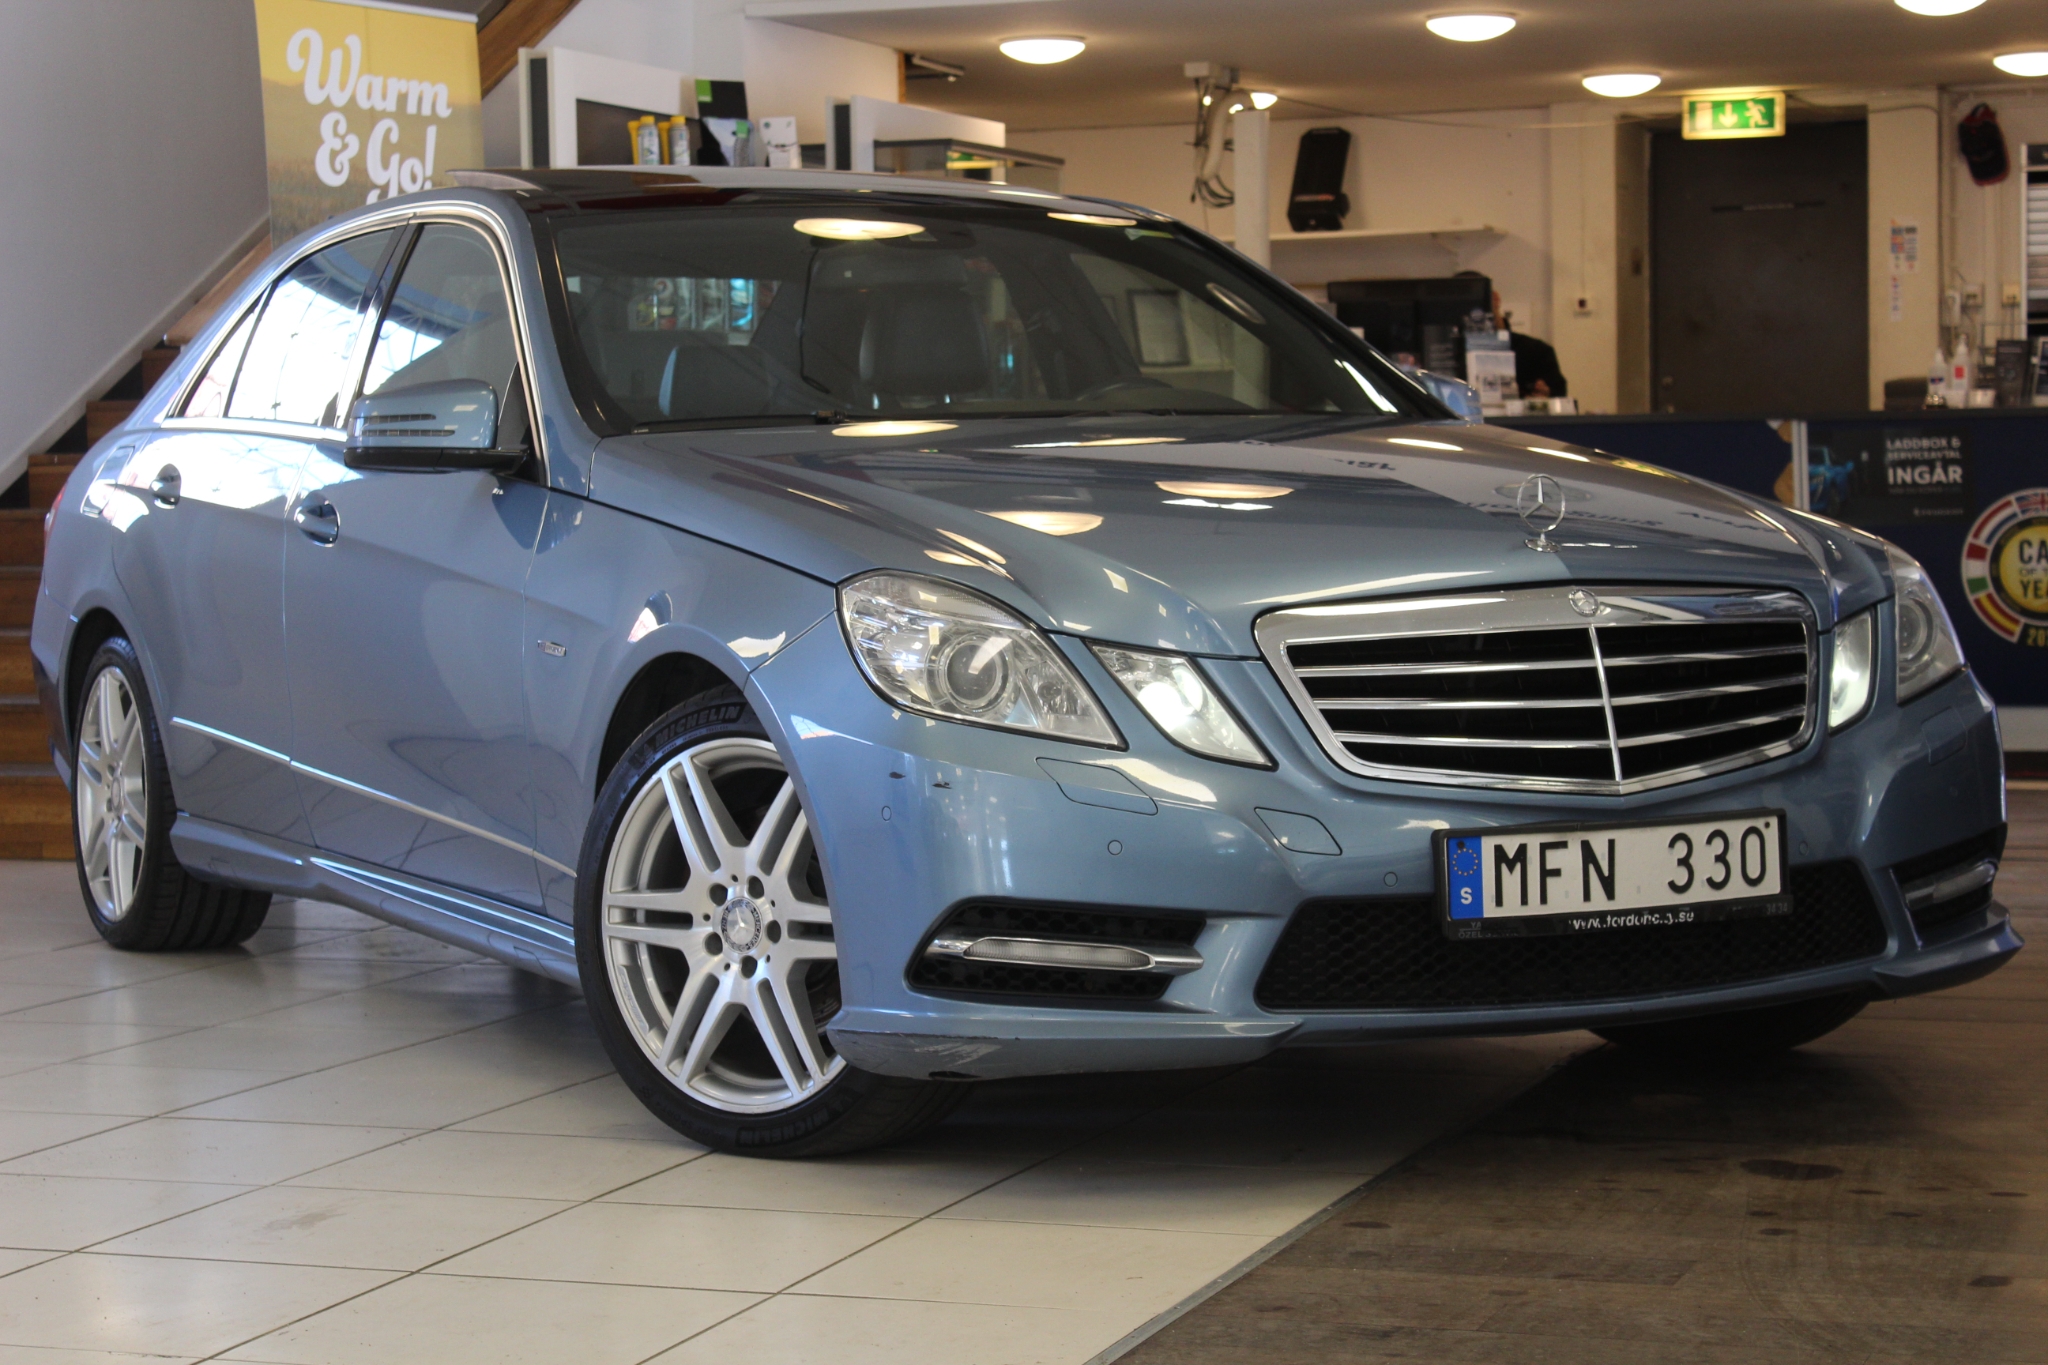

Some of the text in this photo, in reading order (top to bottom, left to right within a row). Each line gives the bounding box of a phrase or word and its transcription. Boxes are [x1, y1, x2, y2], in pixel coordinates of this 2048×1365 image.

[286, 27, 452, 118] Warm
[315, 111, 437, 205] & Go!
[1887, 461, 1964, 485] INGÅR
[2019, 578, 2048, 599] YE
[655, 705, 741, 748] MICHELIN
[1493, 825, 1767, 908] MFN 330
[1460, 887, 1473, 905] S
[738, 1107, 830, 1145] MICHELIN
